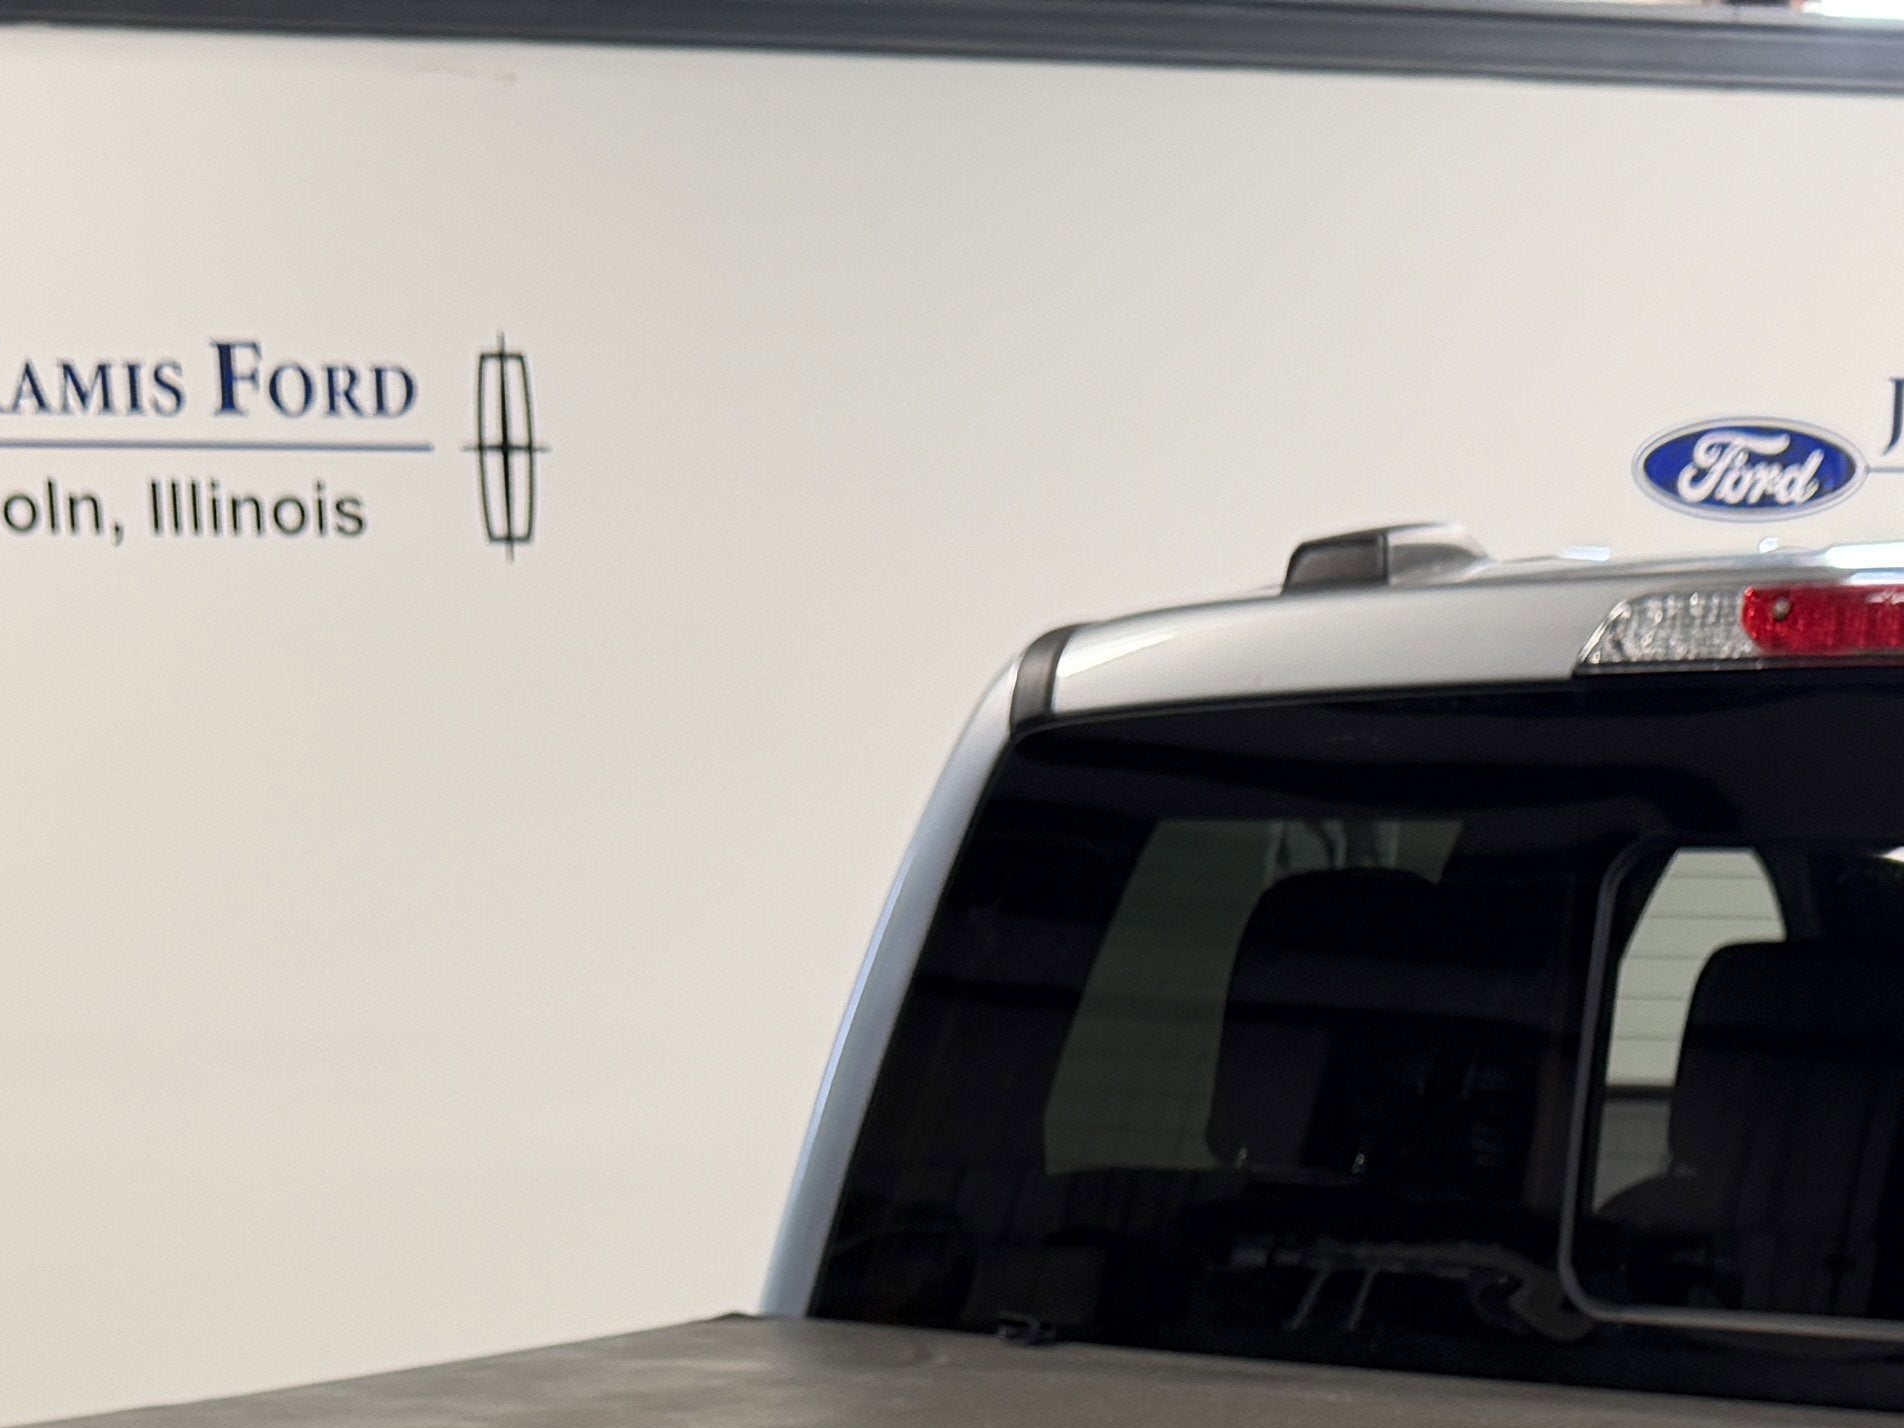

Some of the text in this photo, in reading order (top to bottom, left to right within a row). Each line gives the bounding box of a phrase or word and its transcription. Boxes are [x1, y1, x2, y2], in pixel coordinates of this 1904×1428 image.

[208, 339, 416, 420] FORD
[1676, 433, 1820, 505] Ford
[151, 480, 366, 539] Illinois
